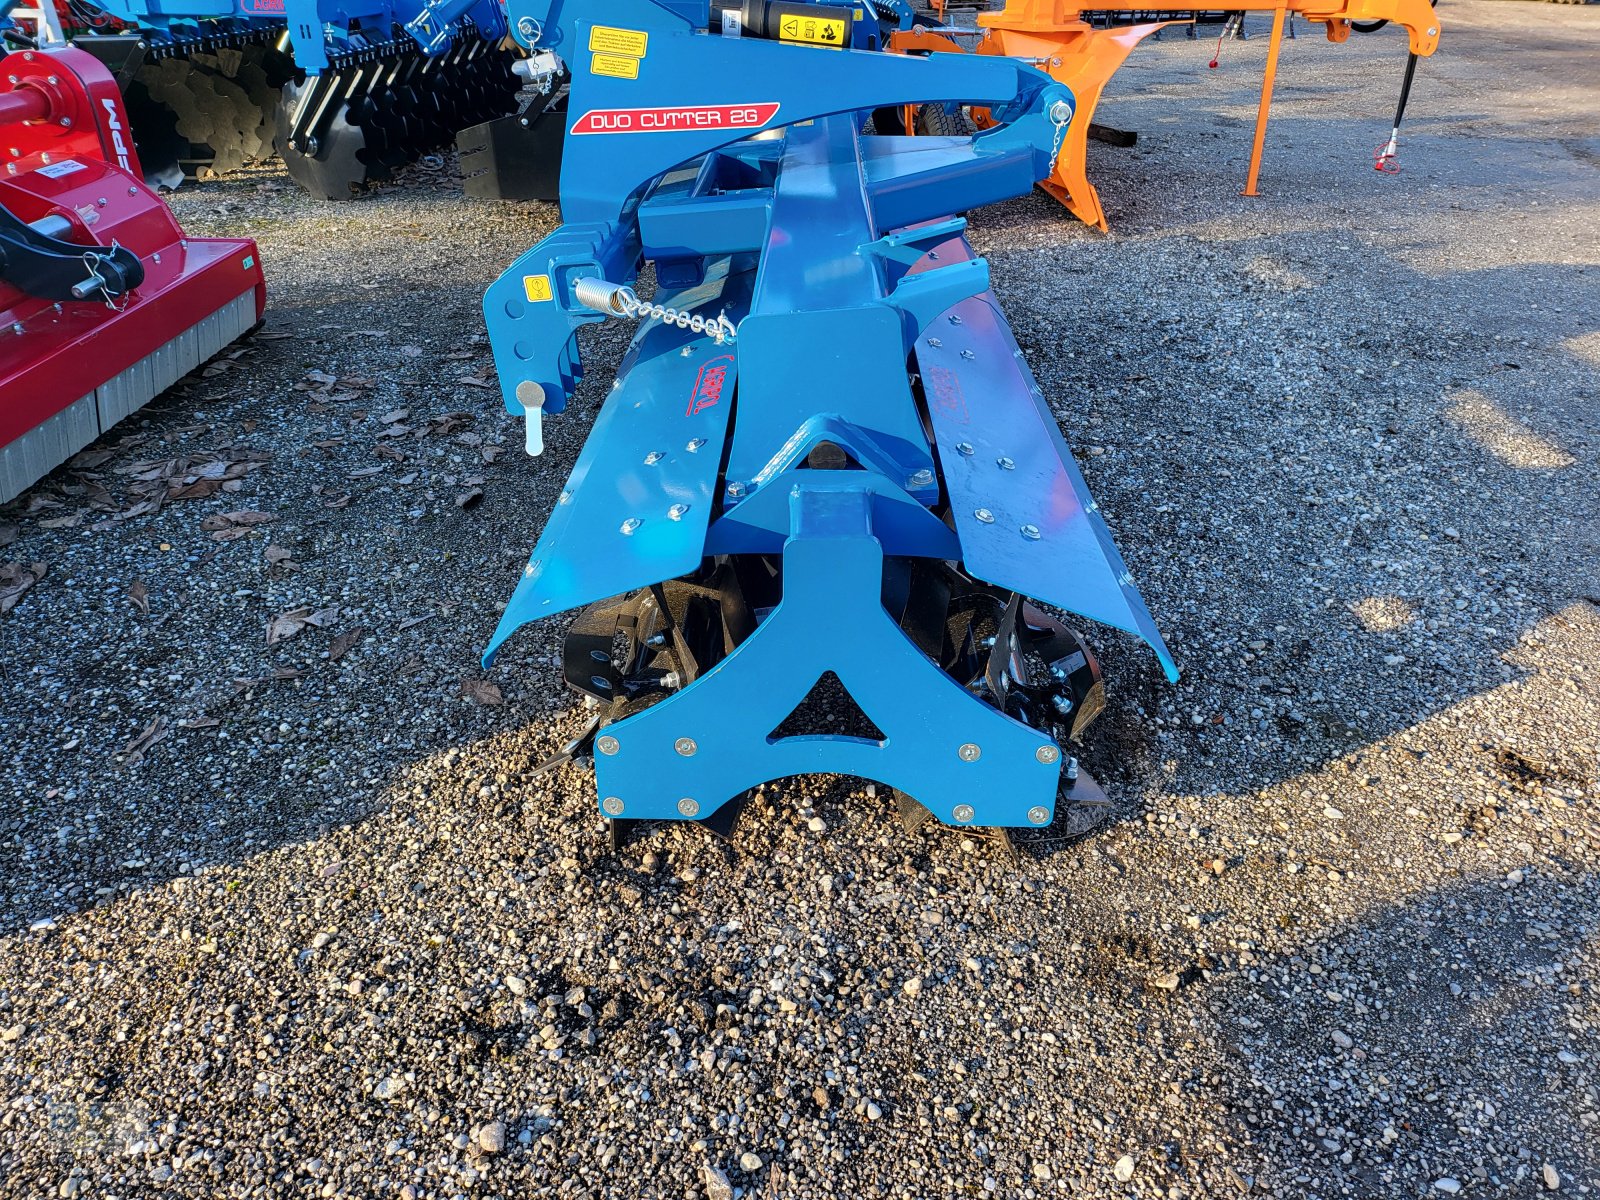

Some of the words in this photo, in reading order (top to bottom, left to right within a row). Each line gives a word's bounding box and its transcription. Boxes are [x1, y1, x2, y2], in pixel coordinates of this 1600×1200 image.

[101, 98, 134, 174] FPM
[590, 114, 631, 129] DUO
[640, 111, 721, 127] CUTTER
[730, 109, 758, 123] 2G
